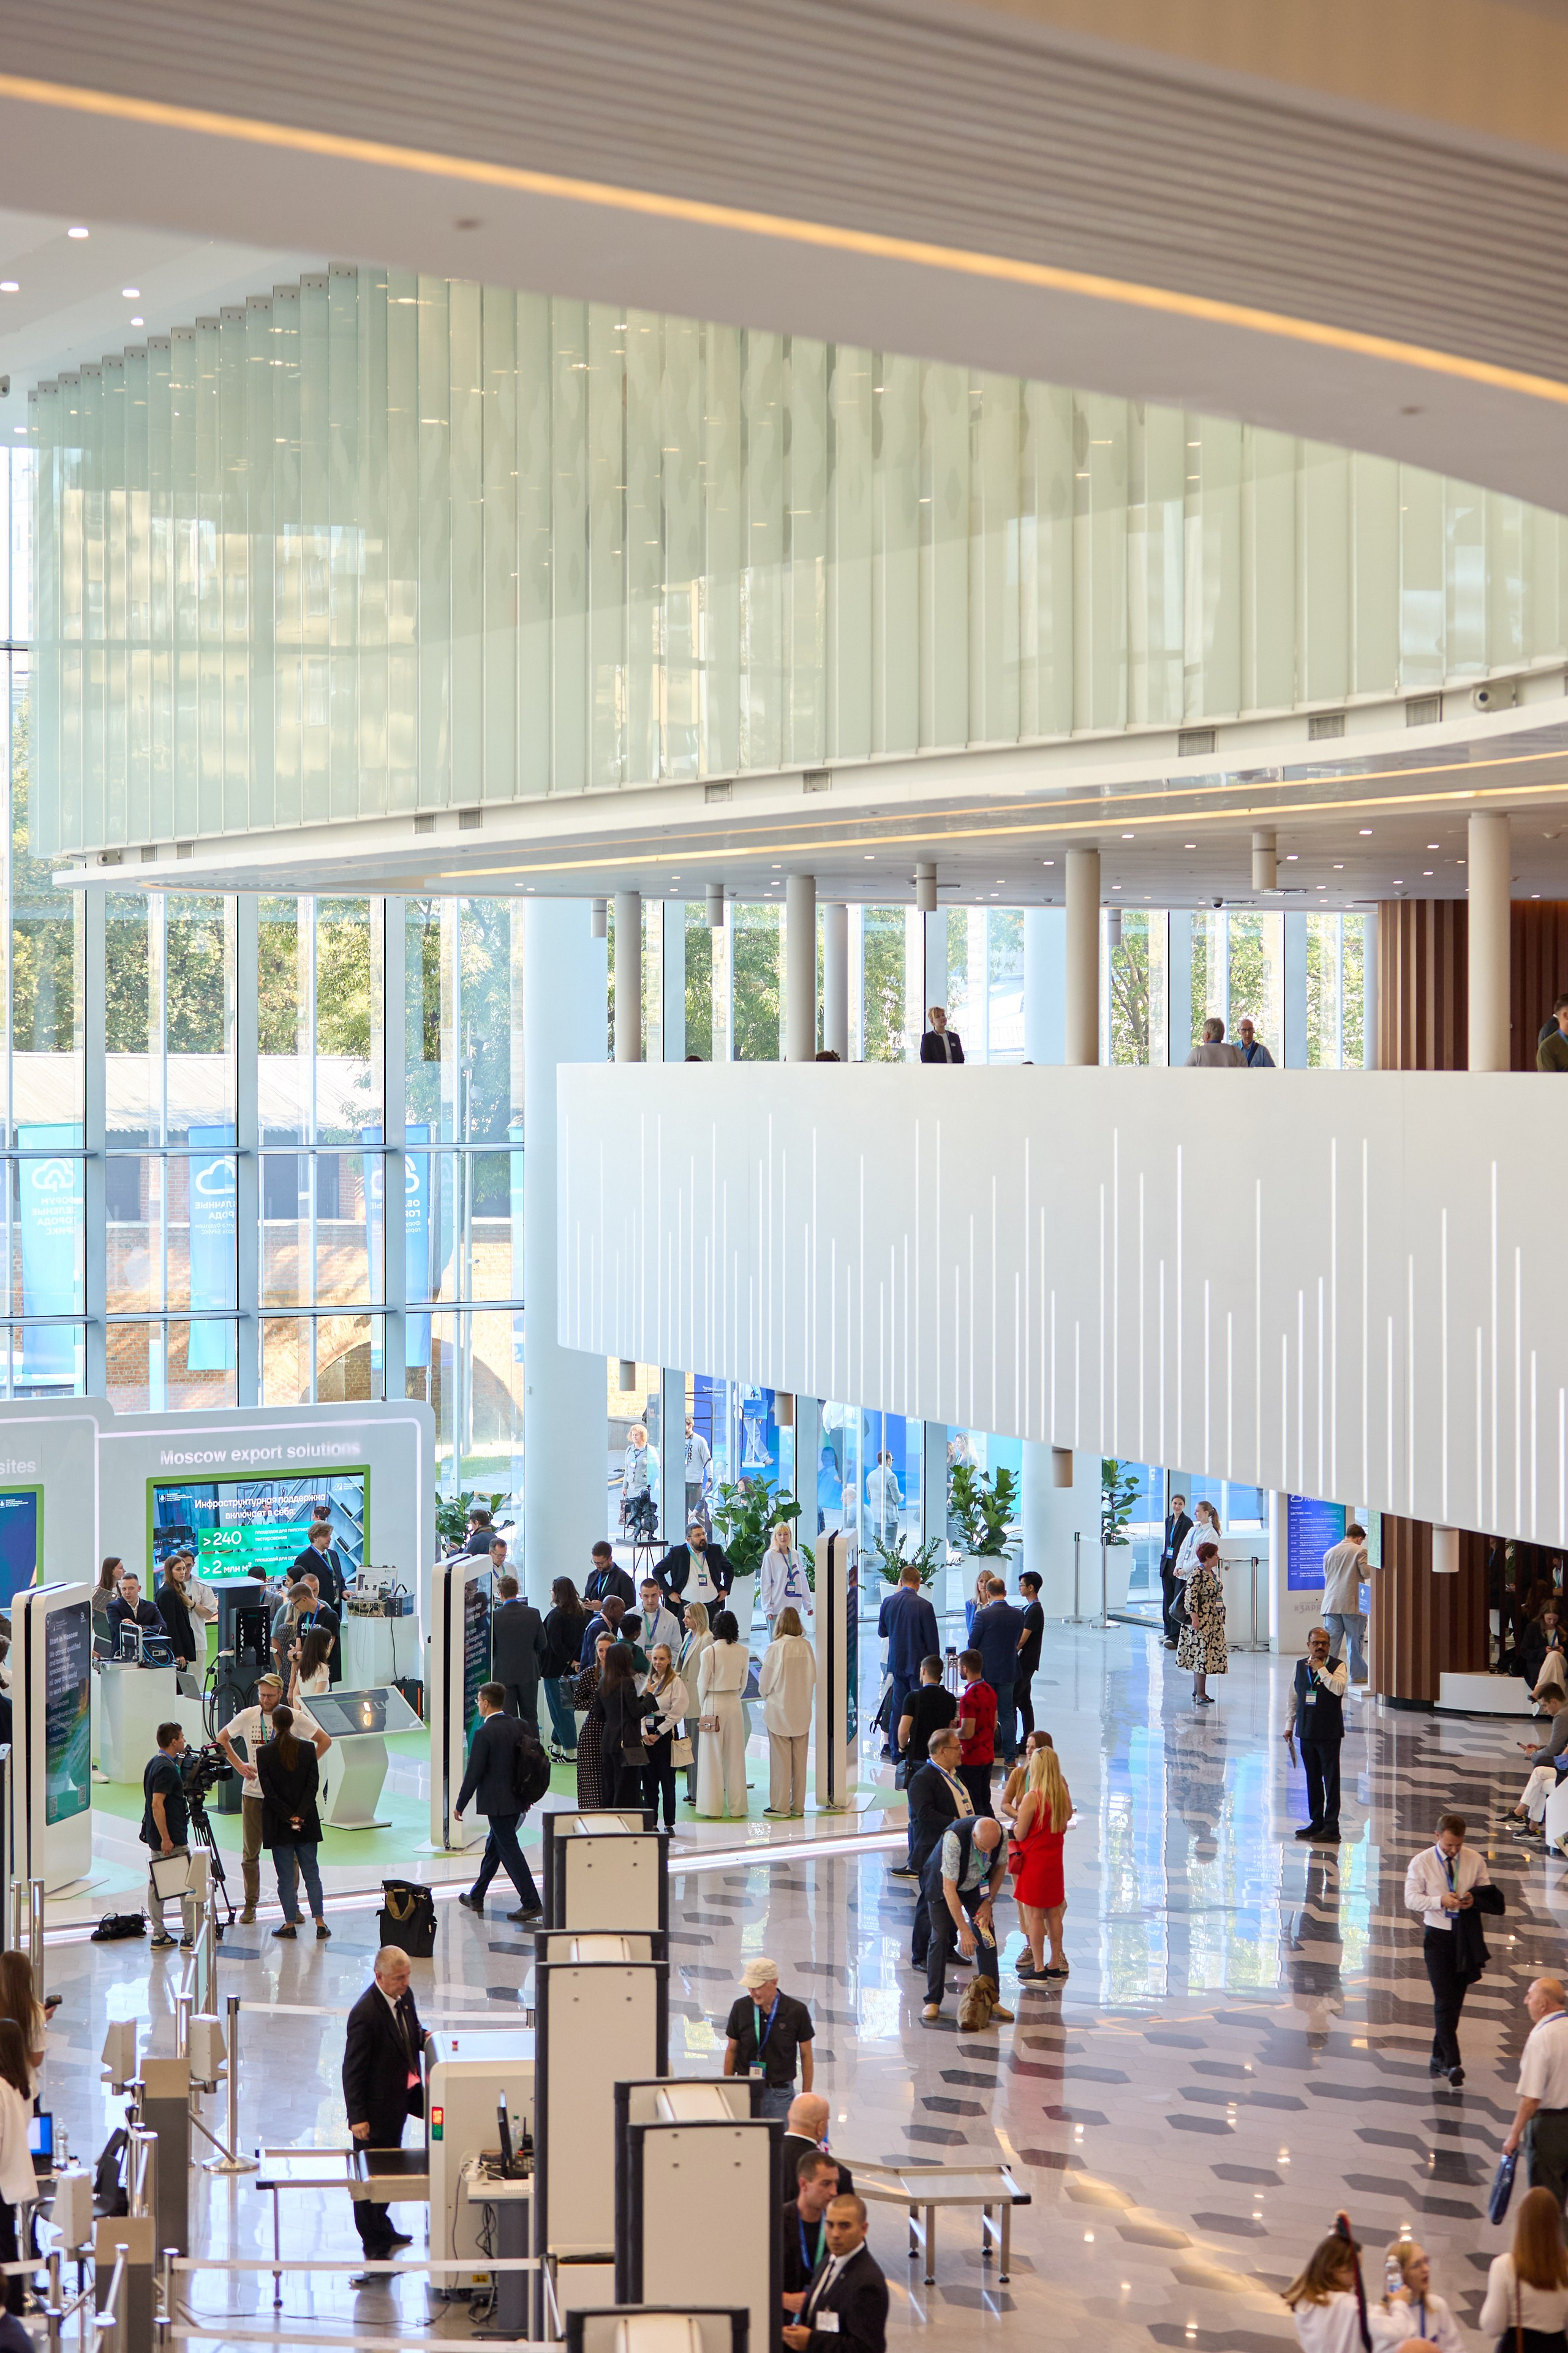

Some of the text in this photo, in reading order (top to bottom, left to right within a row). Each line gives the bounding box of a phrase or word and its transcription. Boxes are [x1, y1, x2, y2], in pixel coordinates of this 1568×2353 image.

[160, 1440, 362, 1466] Moscow export solutions
[0, 1459, 37, 1475] sites
[194, 1496, 277, 1509] Инфраструктурная
[278, 1494, 326, 1506] поддержка
[225, 1510, 266, 1520] включает
[274, 1507, 296, 1516] себя:
[213, 1531, 243, 1546] 240
[212, 1560, 222, 1575] 2
[223, 1565, 241, 1574] млн
[63, 1631, 78, 1642] Moscow
